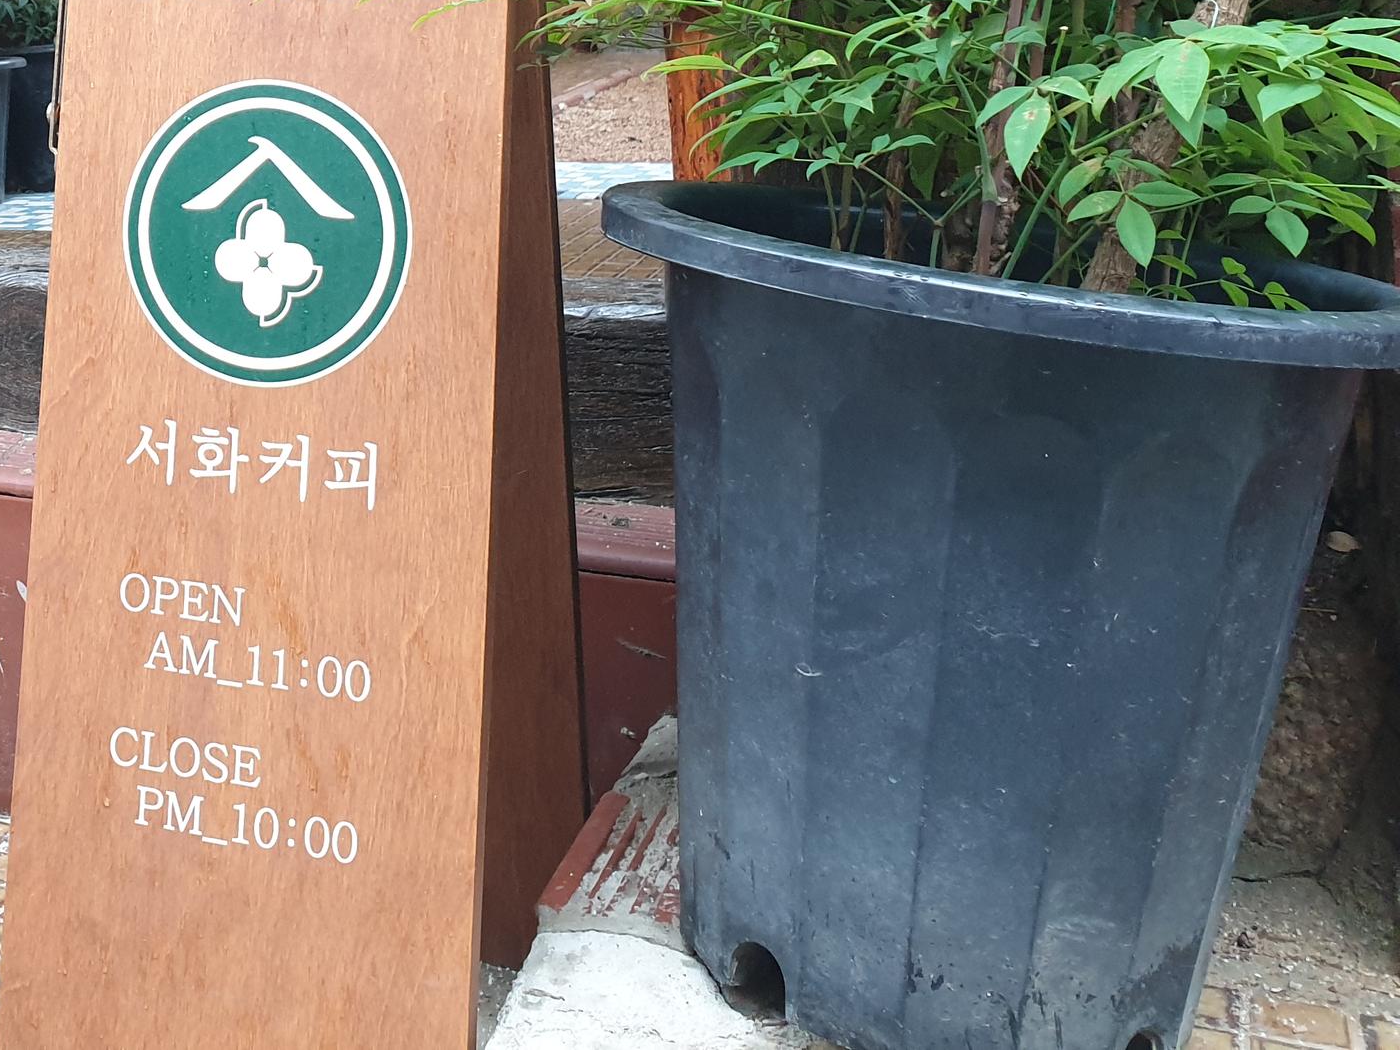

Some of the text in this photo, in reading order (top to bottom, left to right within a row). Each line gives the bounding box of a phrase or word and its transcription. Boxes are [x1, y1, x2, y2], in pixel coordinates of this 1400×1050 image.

[125, 418, 379, 512] 서화커피
[119, 572, 247, 628] OPEN
[142, 629, 372, 704] AM_11:00
[109, 726, 263, 790] CLOSE
[134, 784, 359, 865] PM_10:00
